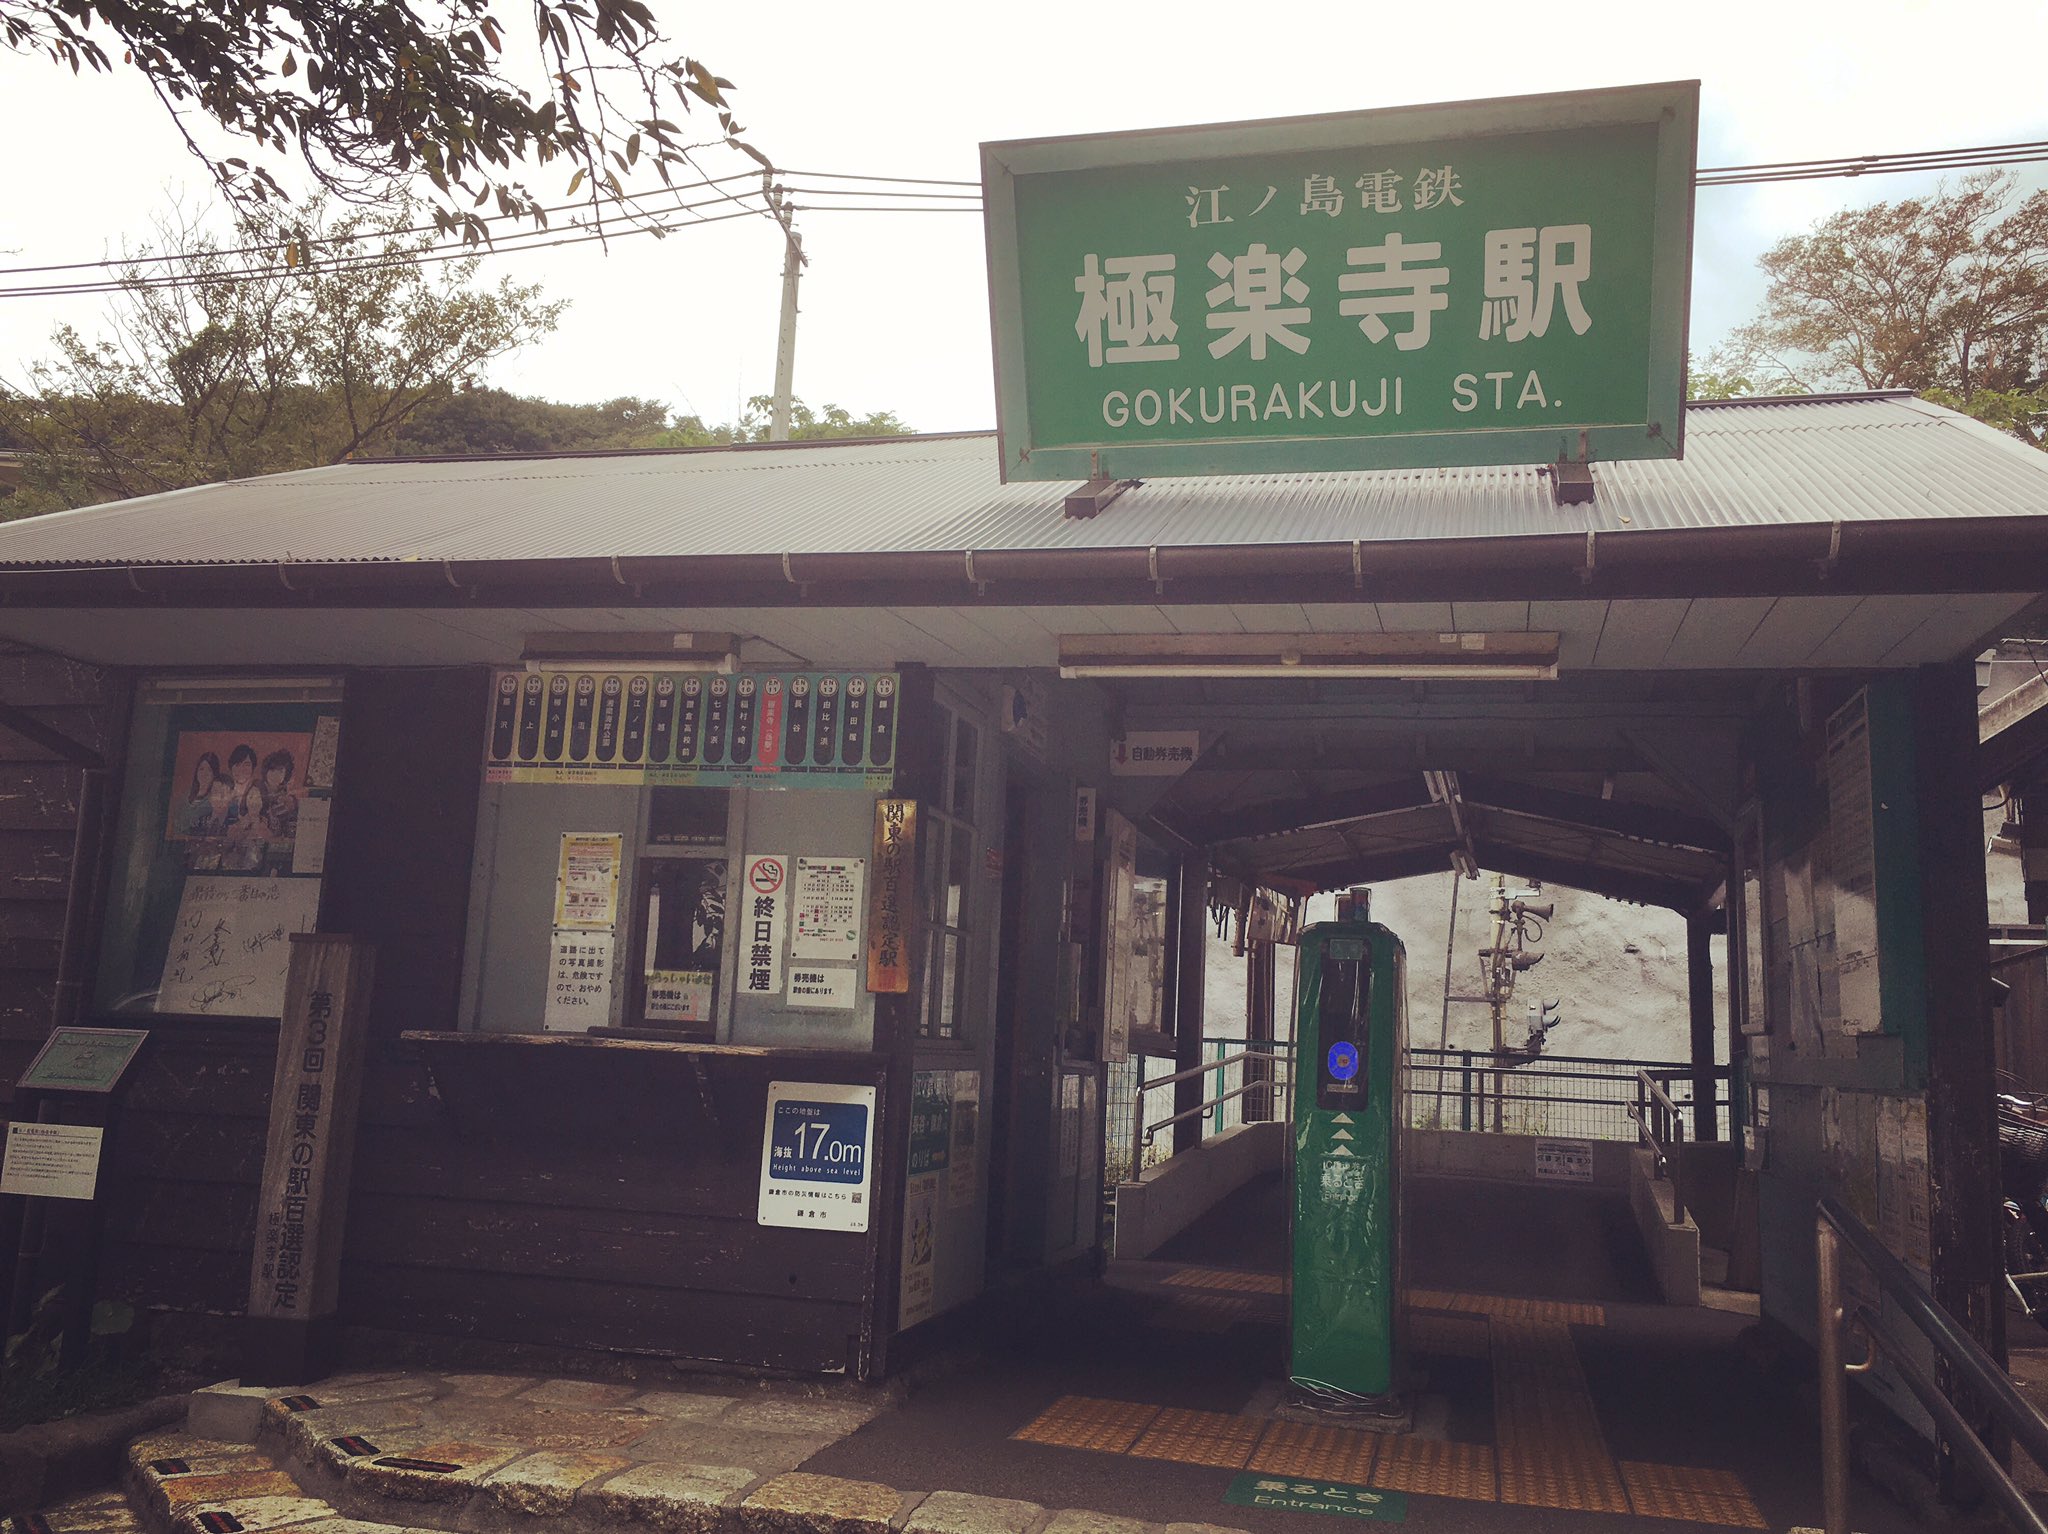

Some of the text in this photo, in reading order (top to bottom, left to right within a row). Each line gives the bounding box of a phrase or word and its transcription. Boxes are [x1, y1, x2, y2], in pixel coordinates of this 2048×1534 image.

[1186, 165, 1465, 228] 江ノ島電鉄
[1075, 223, 1592, 367] 極楽寺駅
[1103, 370, 1562, 428] GOKURAKUJI STA.
[1132, 746, 1193, 761] 自動券売機
[879, 804, 905, 967] 関東の駅百選認定駅
[560, 946, 605, 954] 道路に出て
[749, 896, 775, 990] 終日禁煙
[559, 959, 604, 967] の写真撮影
[558, 971, 603, 980] は、危険です
[556, 983, 602, 992] ので、おやめ
[556, 996, 589, 1005] ください。
[778, 1107, 821, 1116] ここの地盤は
[274, 990, 333, 1310] 第3回 関東の駅百選認定
[774, 1122, 862, 1163] 海抜 17.0m
[773, 1164, 796, 1172] Height
[801, 1165, 821, 1174] above
[843, 1168, 861, 1176] level
[797, 1210, 827, 1218] 鎌倉市
[261, 1212, 280, 1281] 極楽寺駅
[1254, 1480, 1384, 1504] 乗るとき
[1254, 1495, 1374, 1516] Entrance
